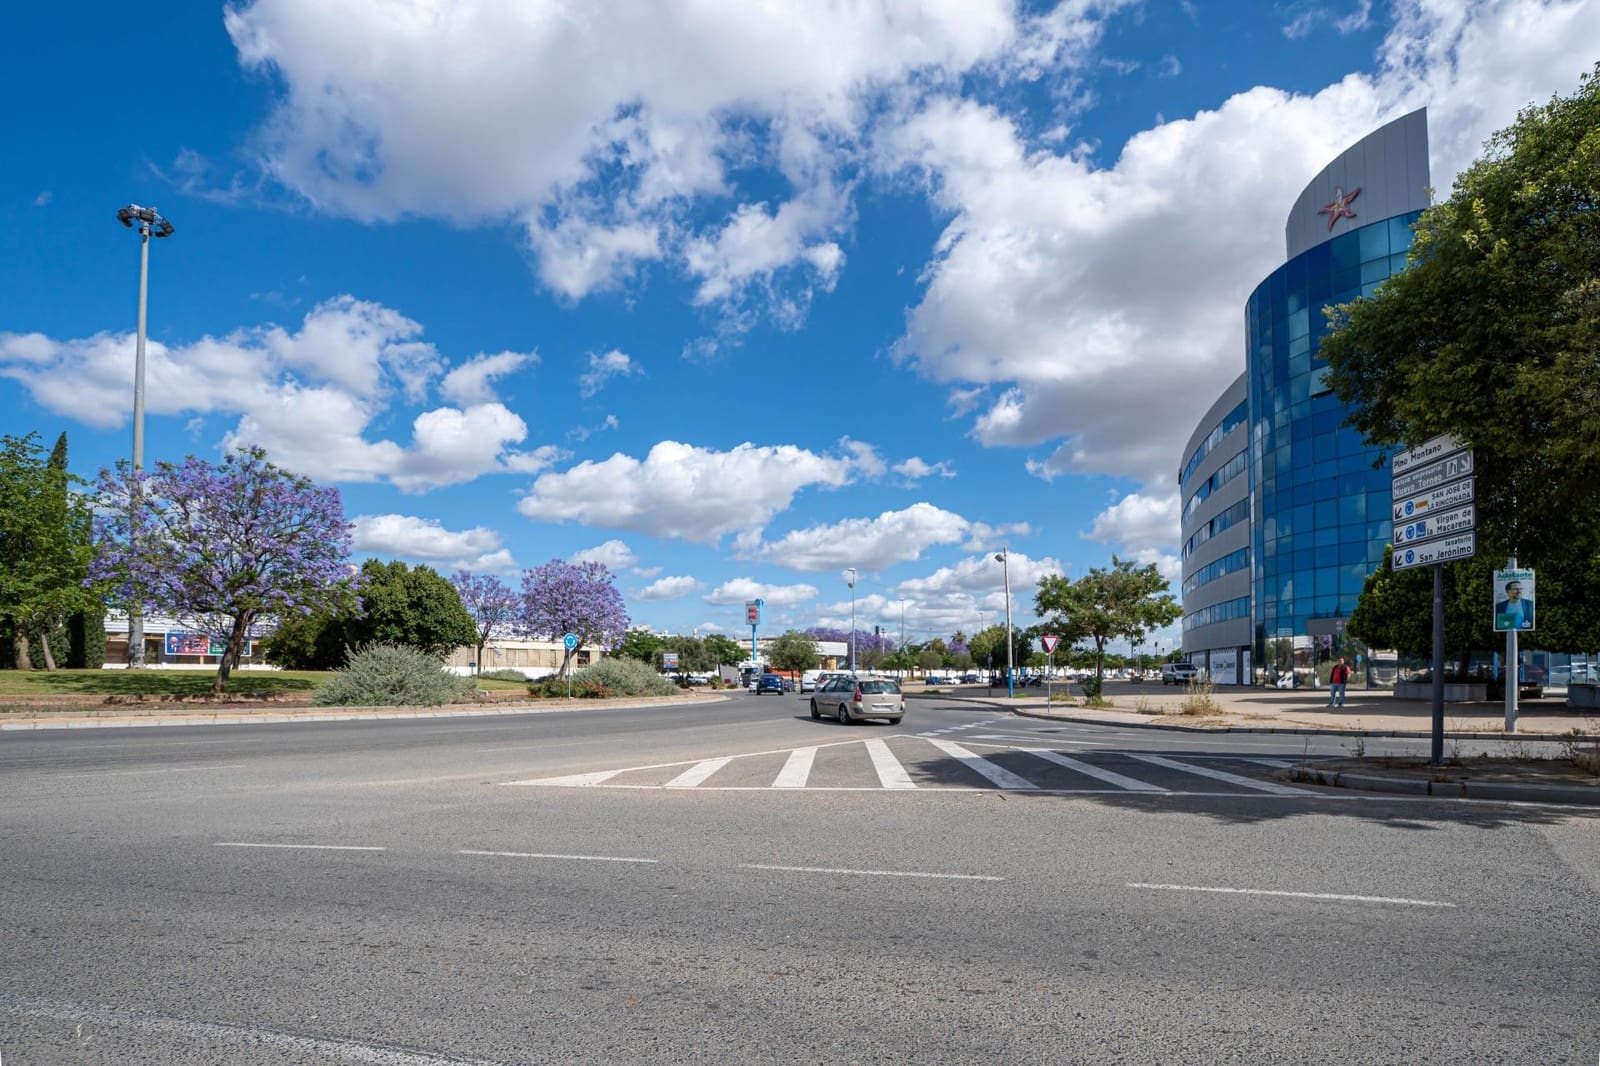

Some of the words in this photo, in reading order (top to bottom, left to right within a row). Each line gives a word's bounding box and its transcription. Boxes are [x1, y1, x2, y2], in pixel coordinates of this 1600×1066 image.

[1394, 459, 1409, 469] Pino
[1411, 444, 1442, 461] Montano
[1431, 491, 1444, 500] SAN
[1462, 481, 1471, 490] DE
[1427, 502, 1435, 510] LA
[1435, 492, 1471, 507] RINCONADA
[1436, 513, 1459, 524] Virgen
[1461, 510, 1471, 518] de
[1427, 527, 1434, 536] la
[1436, 519, 1472, 533] Macarena
[1445, 535, 1472, 547] tanatorio
[1419, 553, 1433, 562] San
